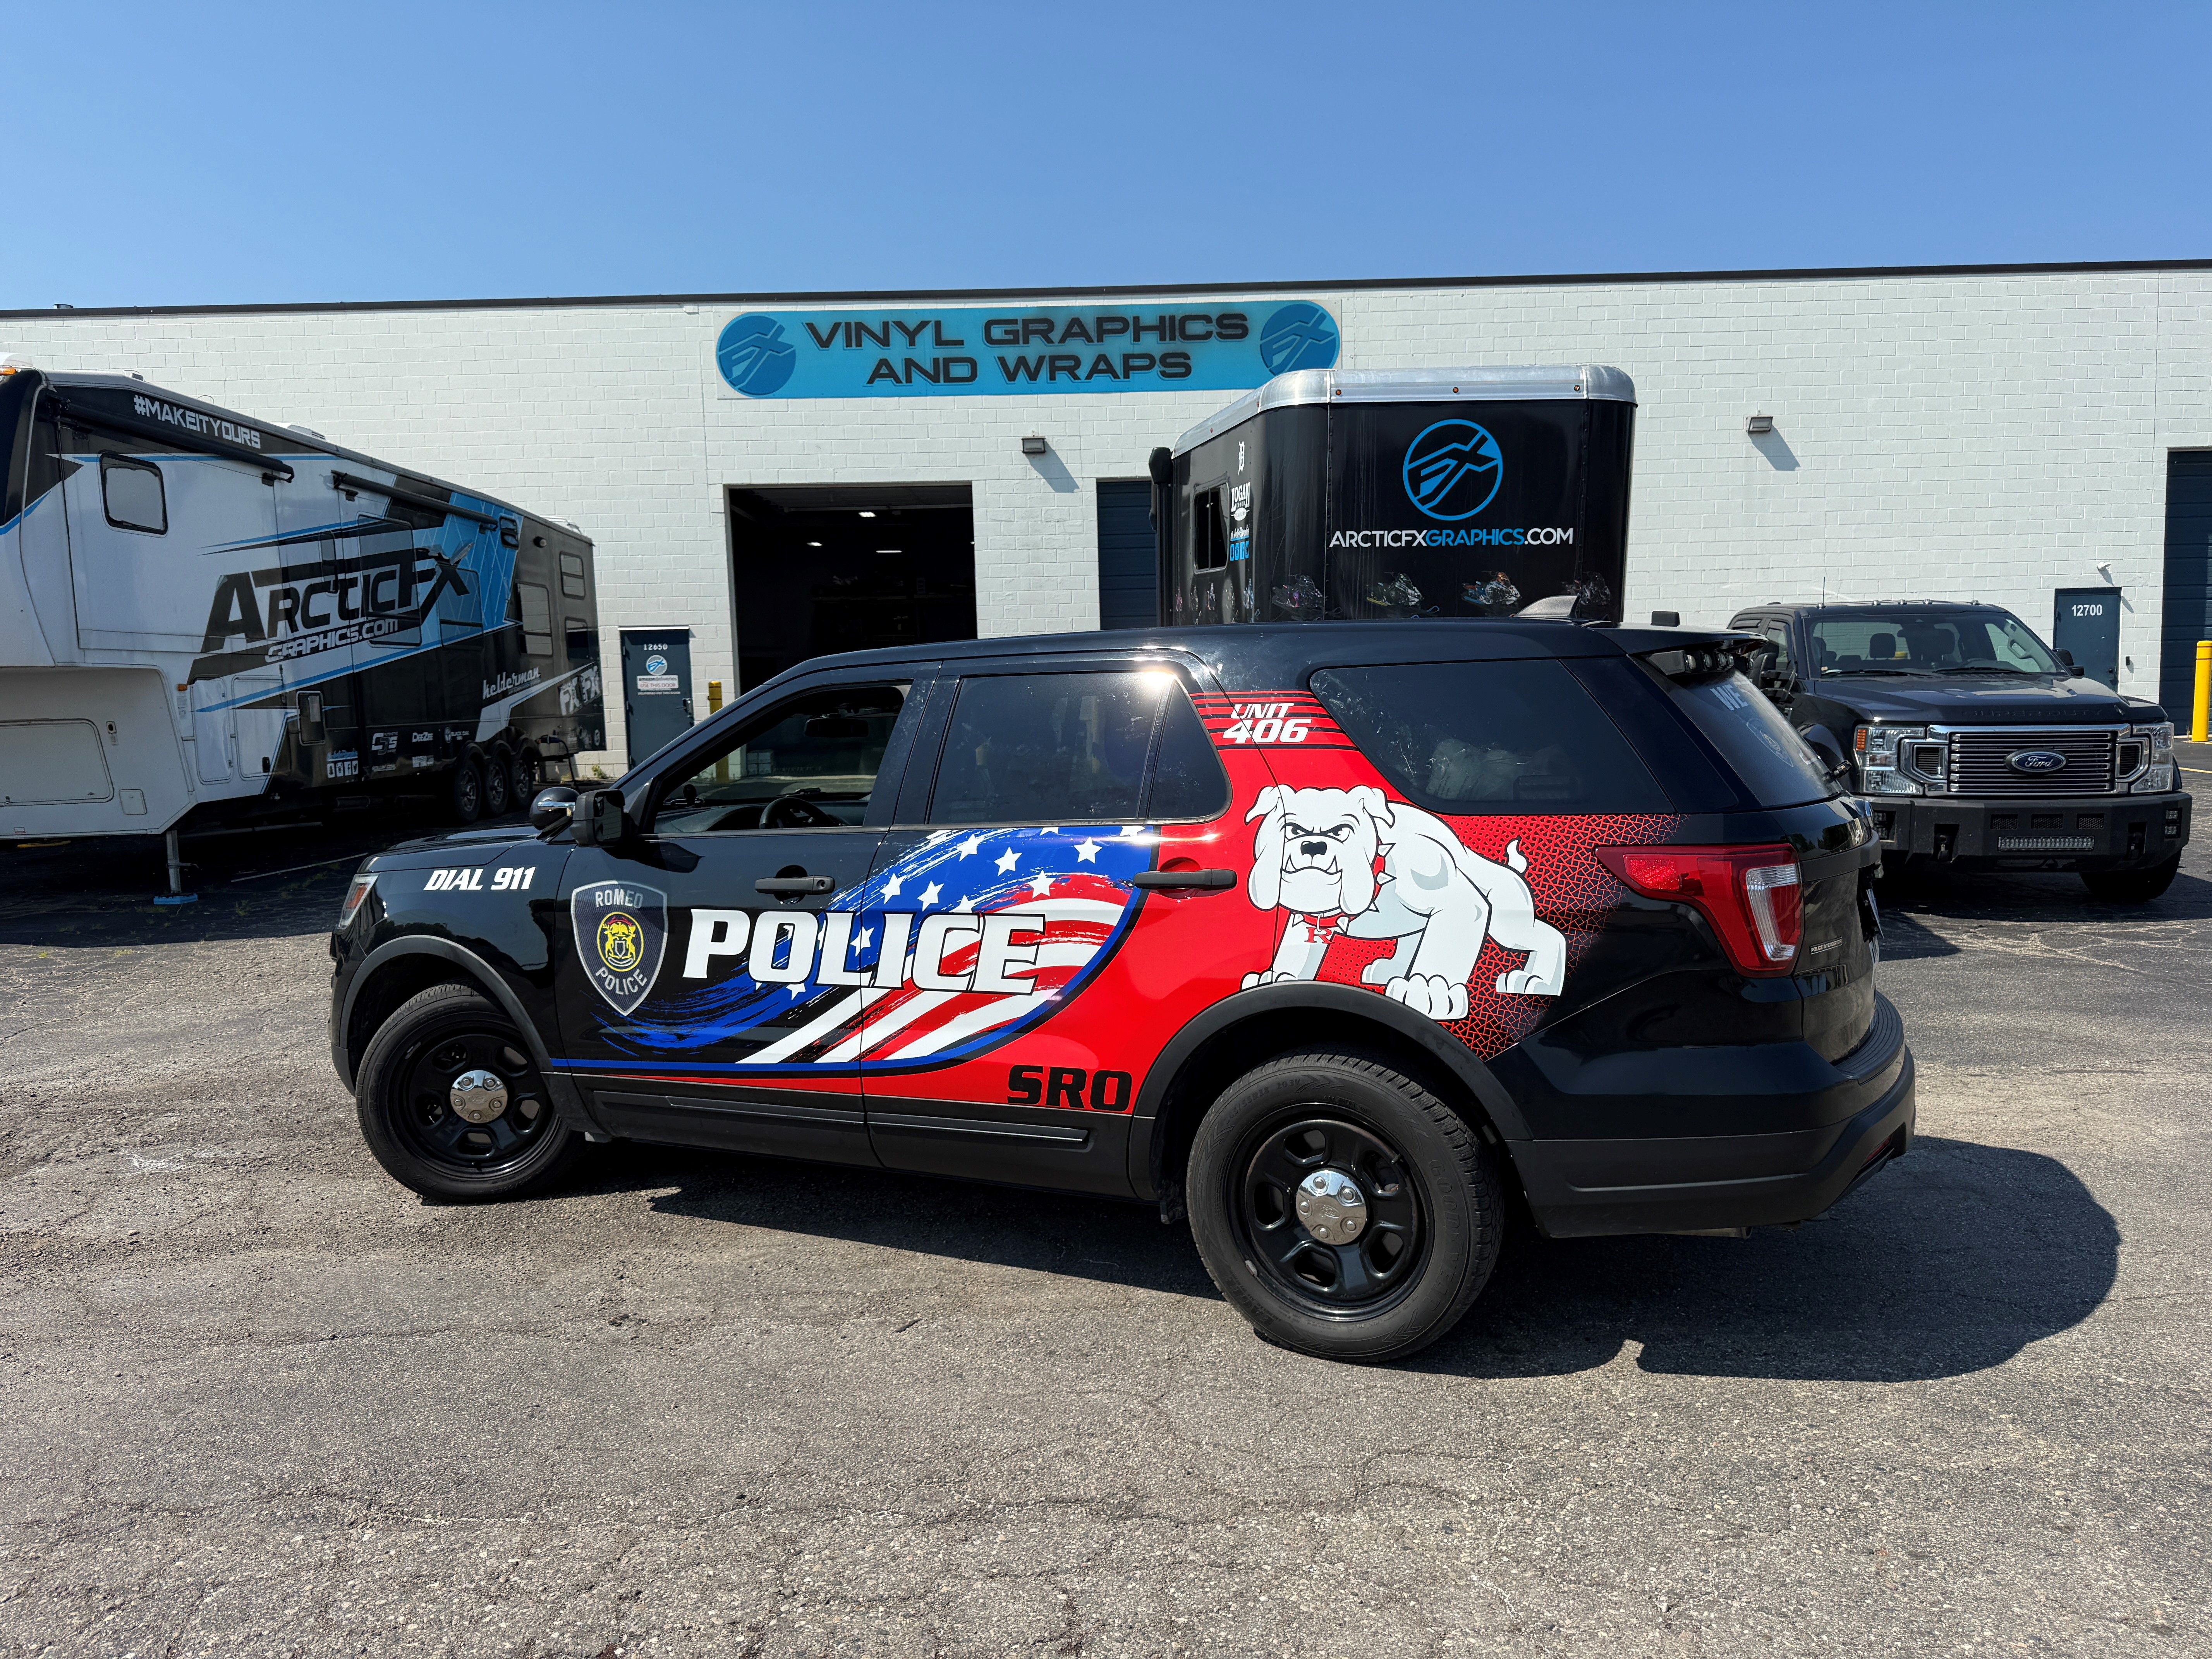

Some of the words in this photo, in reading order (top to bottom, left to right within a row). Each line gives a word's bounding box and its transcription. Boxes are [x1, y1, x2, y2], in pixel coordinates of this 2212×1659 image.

[805, 320, 964, 348] VINYL
[984, 313, 1249, 345] GRAPHICS
[866, 357, 977, 385] AND
[997, 352, 1192, 381] WRAPS
[134, 395, 261, 449] #MAKEITYOURS
[1231, 482, 1250, 512] LOGAN
[1329, 527, 1574, 548] ARCTICFXGRAPHICS.COM
[2071, 604, 2103, 616] 12700
[1230, 702, 1294, 719] UNIT
[1222, 718, 1312, 744] 406
[2024, 755, 2054, 768] Ford
[423, 869, 484, 891] DIAL
[490, 867, 536, 890] 911
[595, 889, 644, 908] ROMEO
[1304, 926, 1336, 945] R
[1811, 945, 1823, 953] POLICE
[1823, 939, 1842, 949] INTERCEPTOR
[682, 908, 1046, 995] POLICE
[596, 966, 648, 995] POLICE
[1007, 1064, 1133, 1112] SRO
